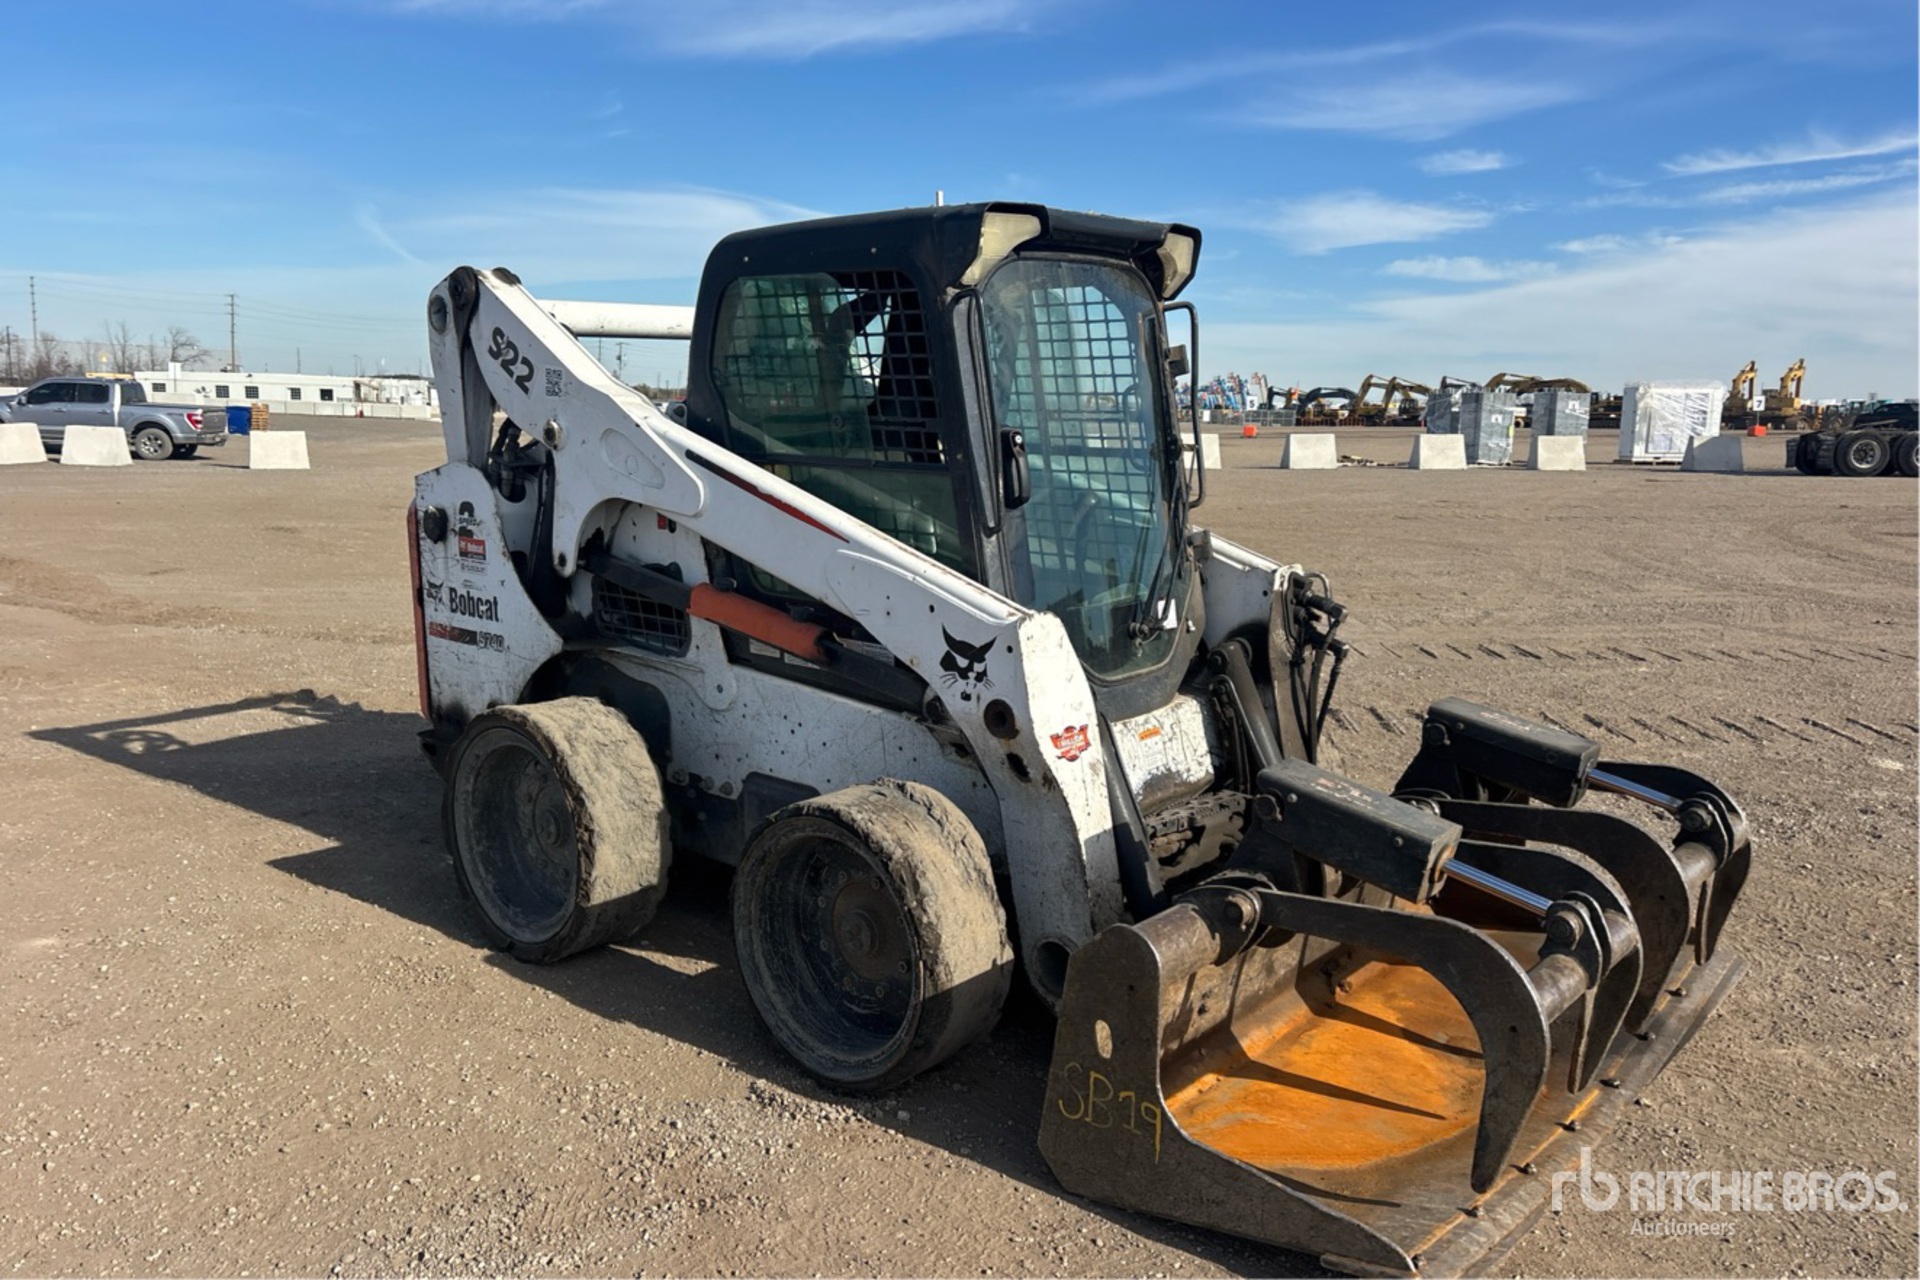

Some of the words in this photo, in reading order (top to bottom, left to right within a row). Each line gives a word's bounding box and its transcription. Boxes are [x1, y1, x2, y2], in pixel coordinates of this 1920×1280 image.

[488, 326, 535, 395] S22
[1249, 400, 1255, 408] 5
[1756, 400, 1762, 408] 7
[449, 587, 499, 622] Bobcat
